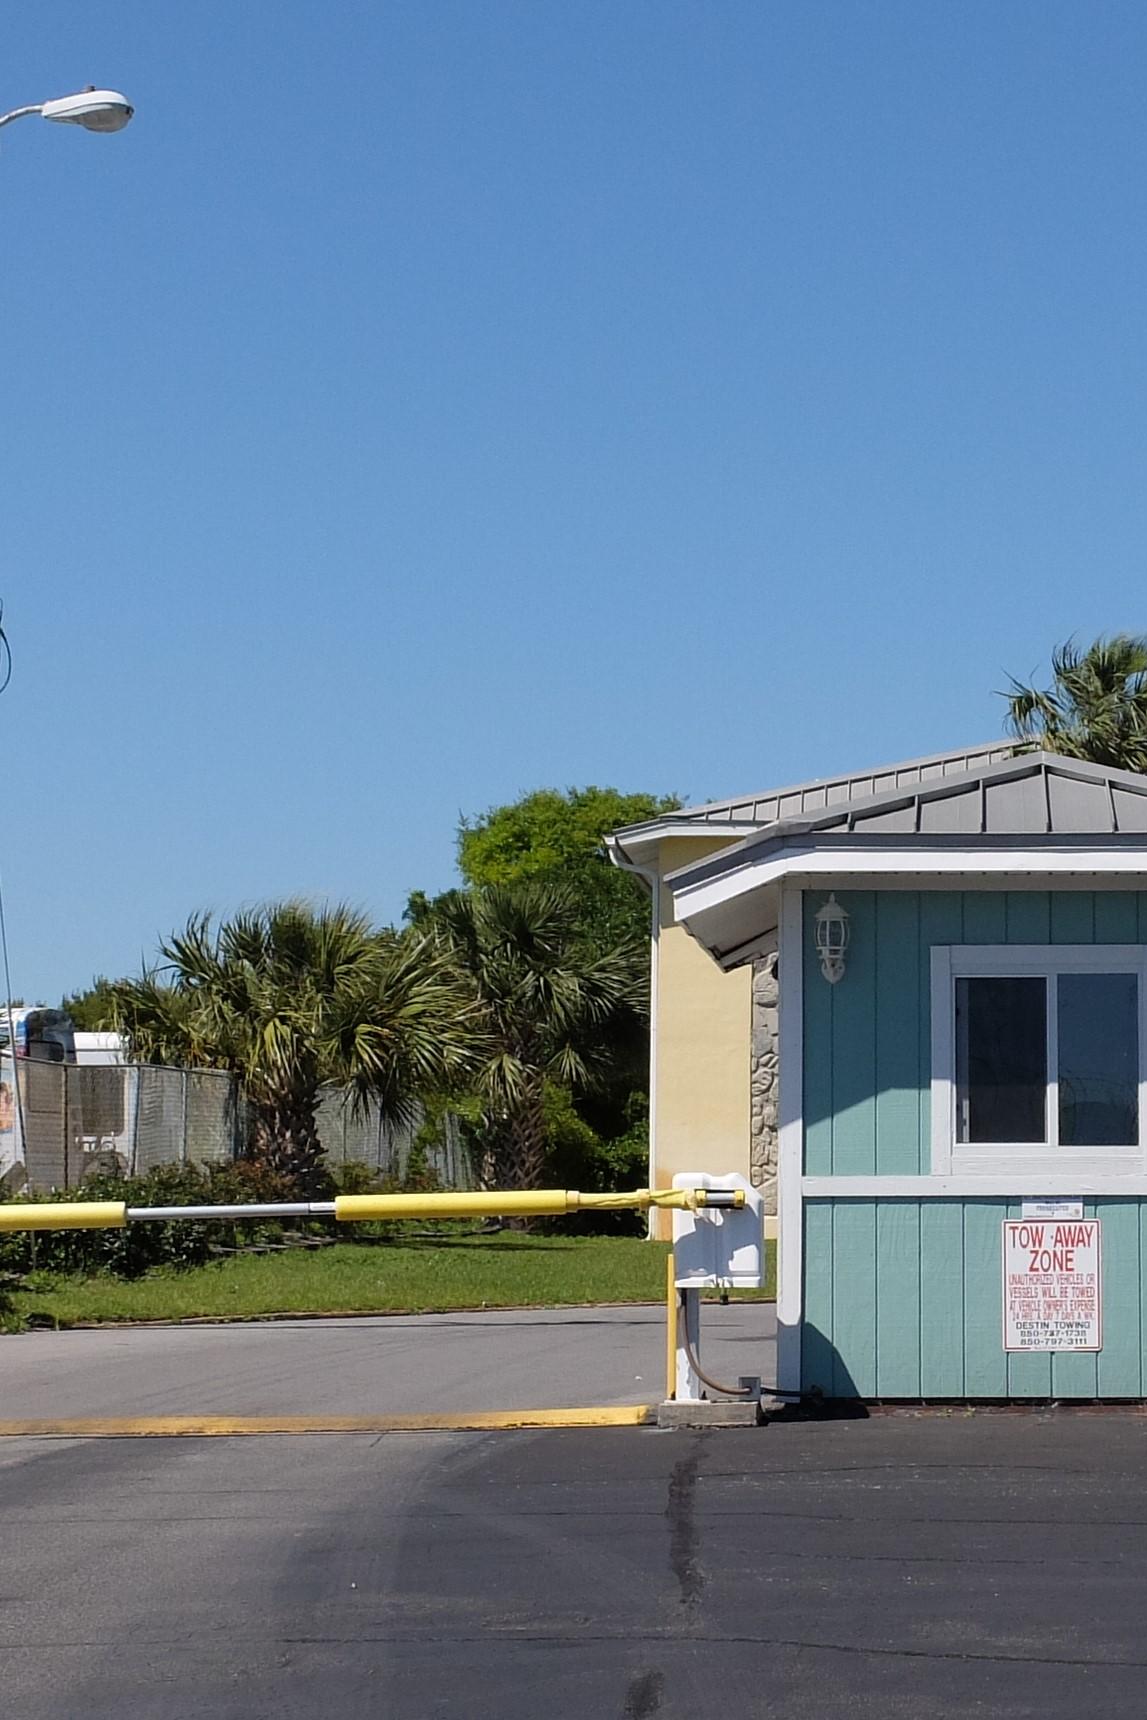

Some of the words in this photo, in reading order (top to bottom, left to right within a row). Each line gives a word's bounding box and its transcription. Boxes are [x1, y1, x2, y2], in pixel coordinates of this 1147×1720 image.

[1009, 1226, 1044, 1248] TOW
[1053, 1225, 1094, 1248] AWAY
[1029, 1250, 1075, 1272] ZONE
[1009, 1274, 1054, 1285] UNAUTHORIZED
[1056, 1274, 1084, 1285] VEHICLES
[1086, 1273, 1095, 1285] OR
[1009, 1287, 1038, 1298] VESSELS
[1042, 1287, 1057, 1298] WILL
[1060, 1287, 1068, 1298] BE
[1071, 1287, 1095, 1298] TOWED
[1009, 1300, 1016, 1311] AT
[1018, 1300, 1040, 1311] VEHICLE
[1070, 1300, 1095, 1311] EXPENSE
[1015, 1321, 1049, 1329] DESTIN
[1054, 1321, 1090, 1329] TOWING
